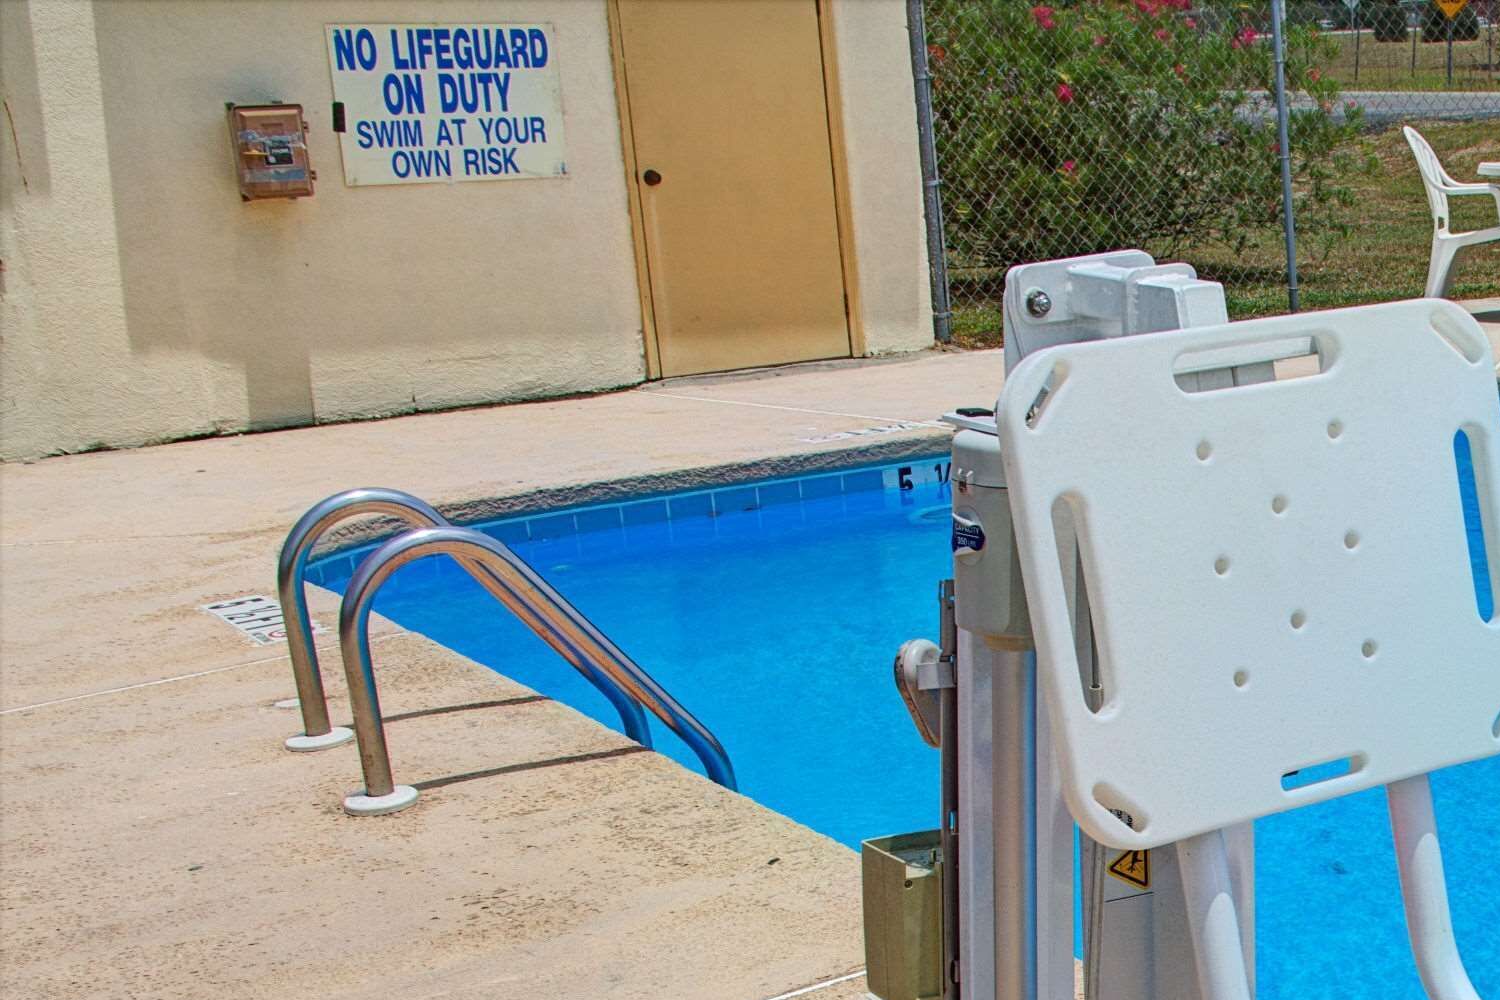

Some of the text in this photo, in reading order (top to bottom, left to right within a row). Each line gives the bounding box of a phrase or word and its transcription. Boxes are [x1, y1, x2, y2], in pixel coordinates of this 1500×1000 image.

[333, 28, 549, 71] NO LIFEGUARD
[382, 72, 511, 116] ON DUTY
[356, 116, 547, 149] SWIM AT YOUR
[392, 147, 521, 178] OWN RISK
